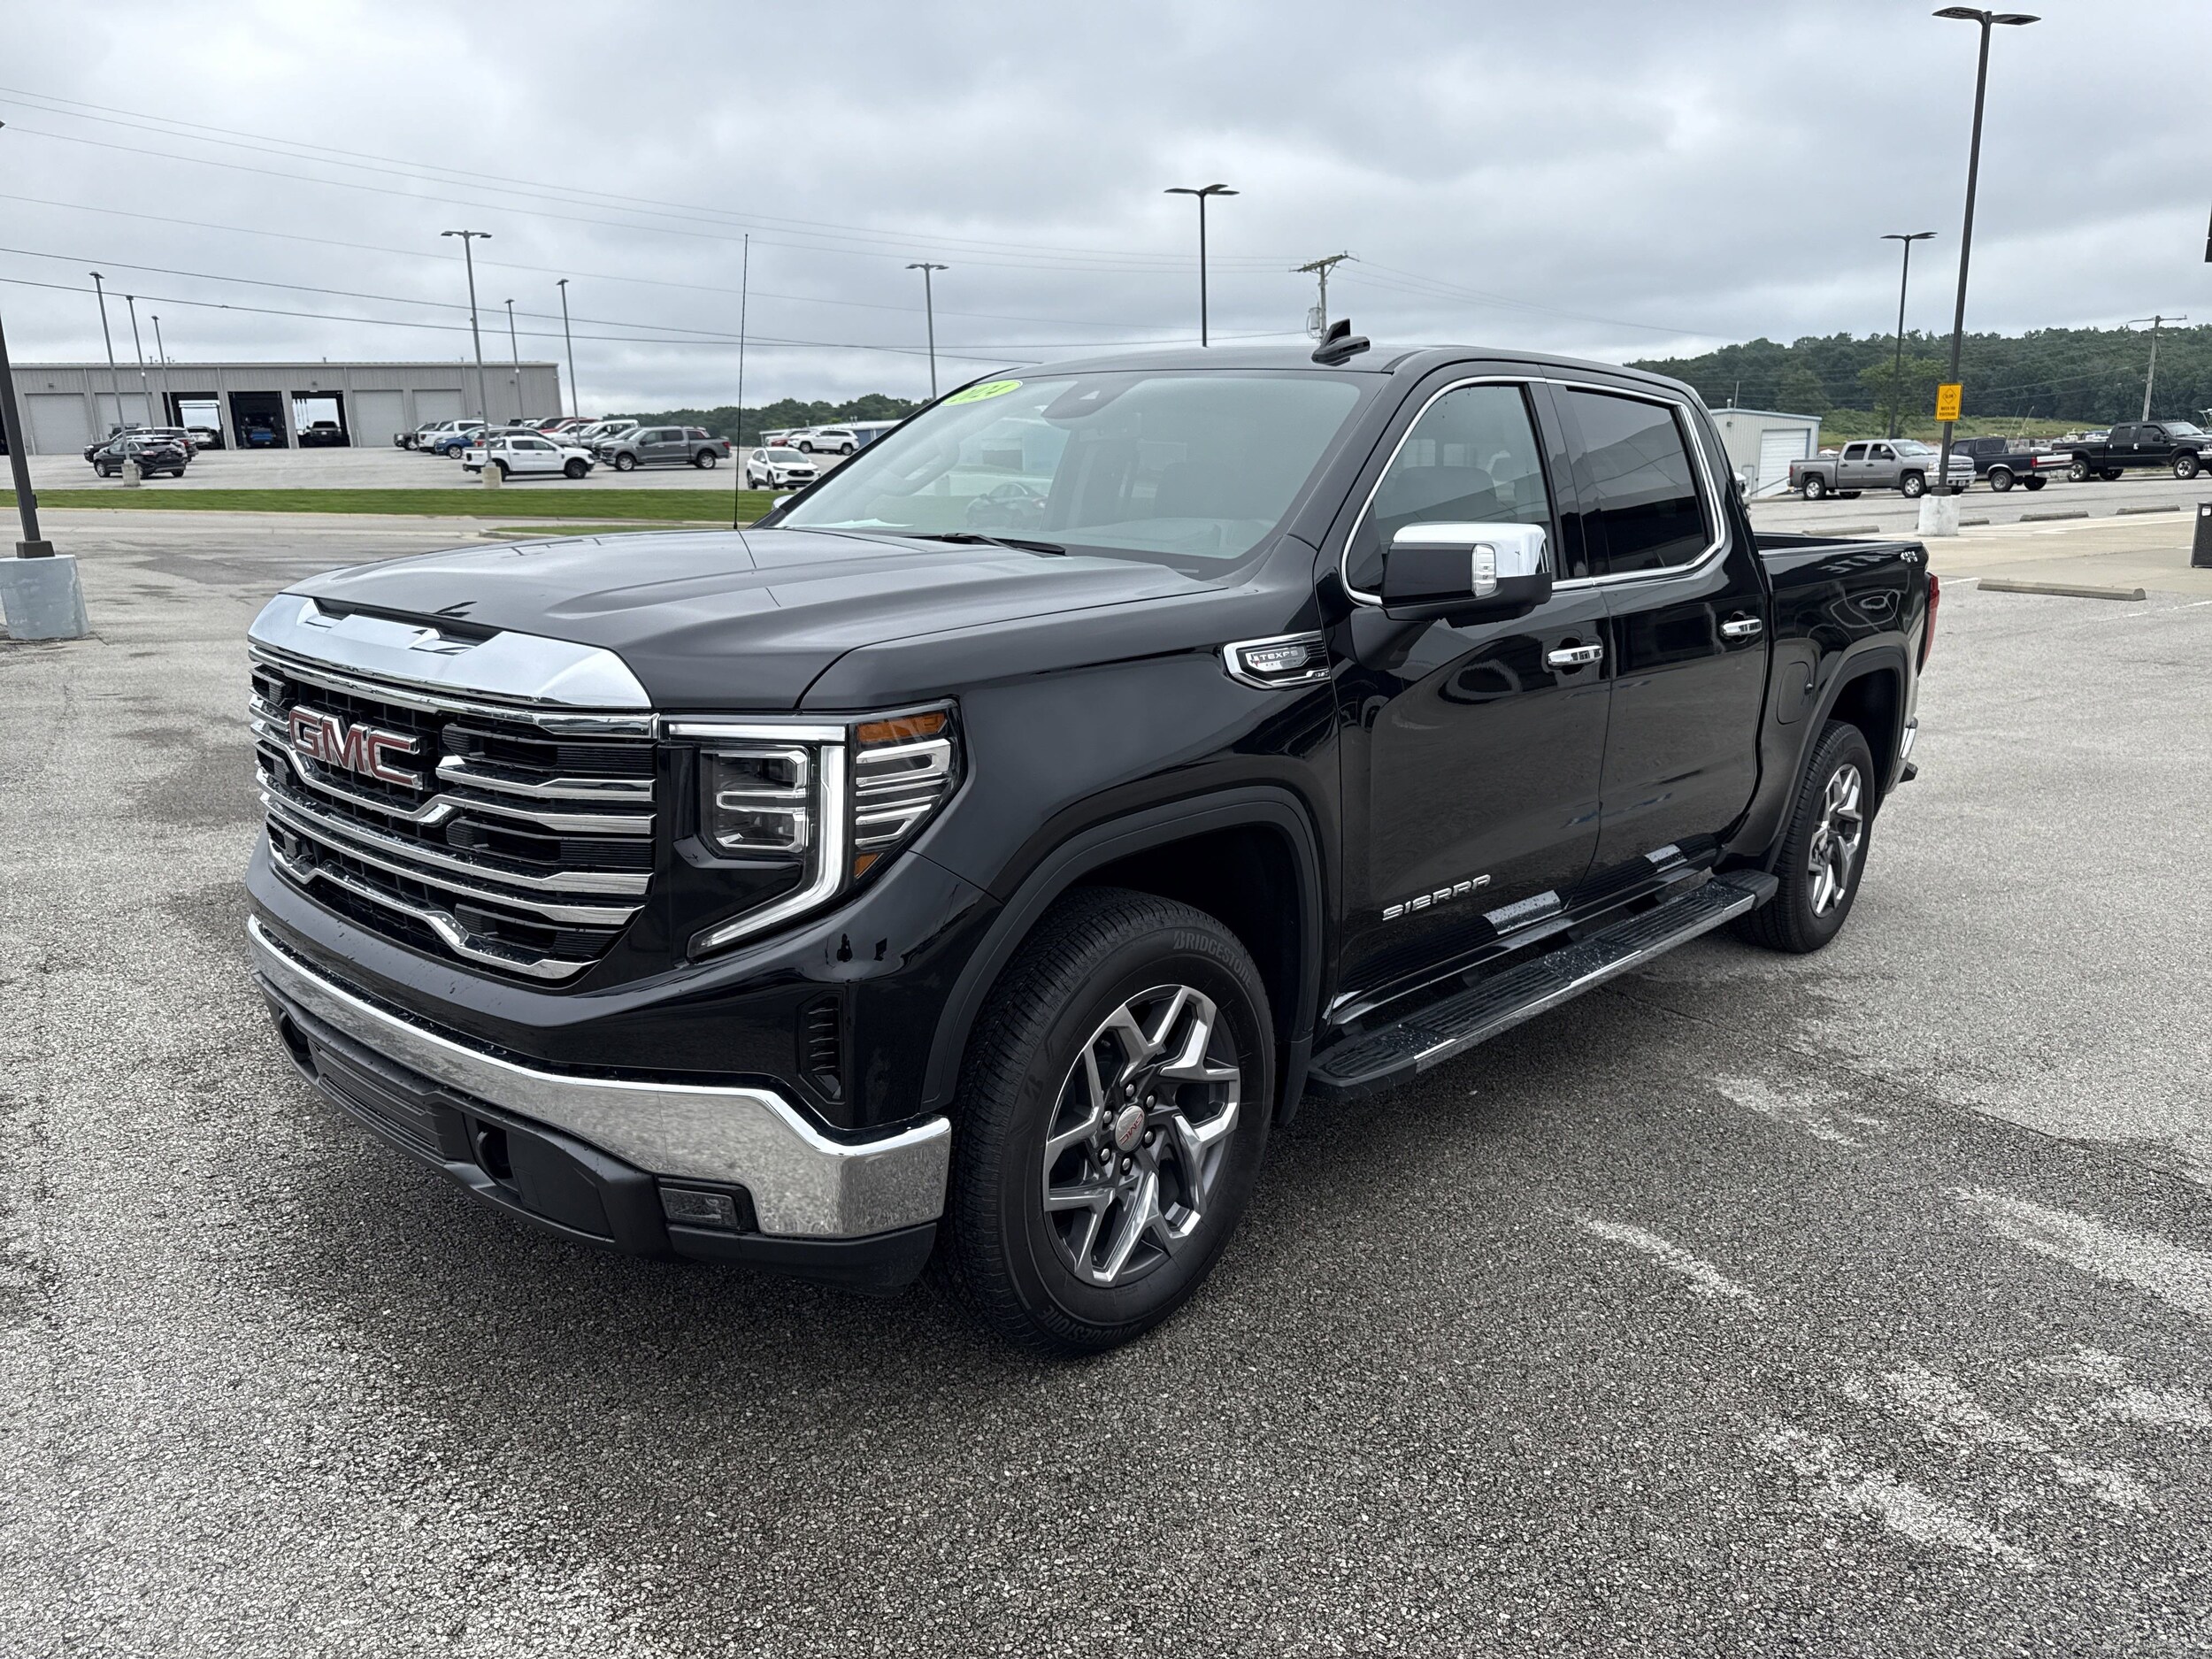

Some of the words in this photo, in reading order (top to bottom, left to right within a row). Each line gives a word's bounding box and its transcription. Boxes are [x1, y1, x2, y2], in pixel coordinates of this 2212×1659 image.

[288, 704, 424, 790] GMC
[1382, 873, 1492, 921] SIERRA
[1173, 930, 1252, 989] BRIDGESTONE
[1118, 1111, 1144, 1146] GMC
